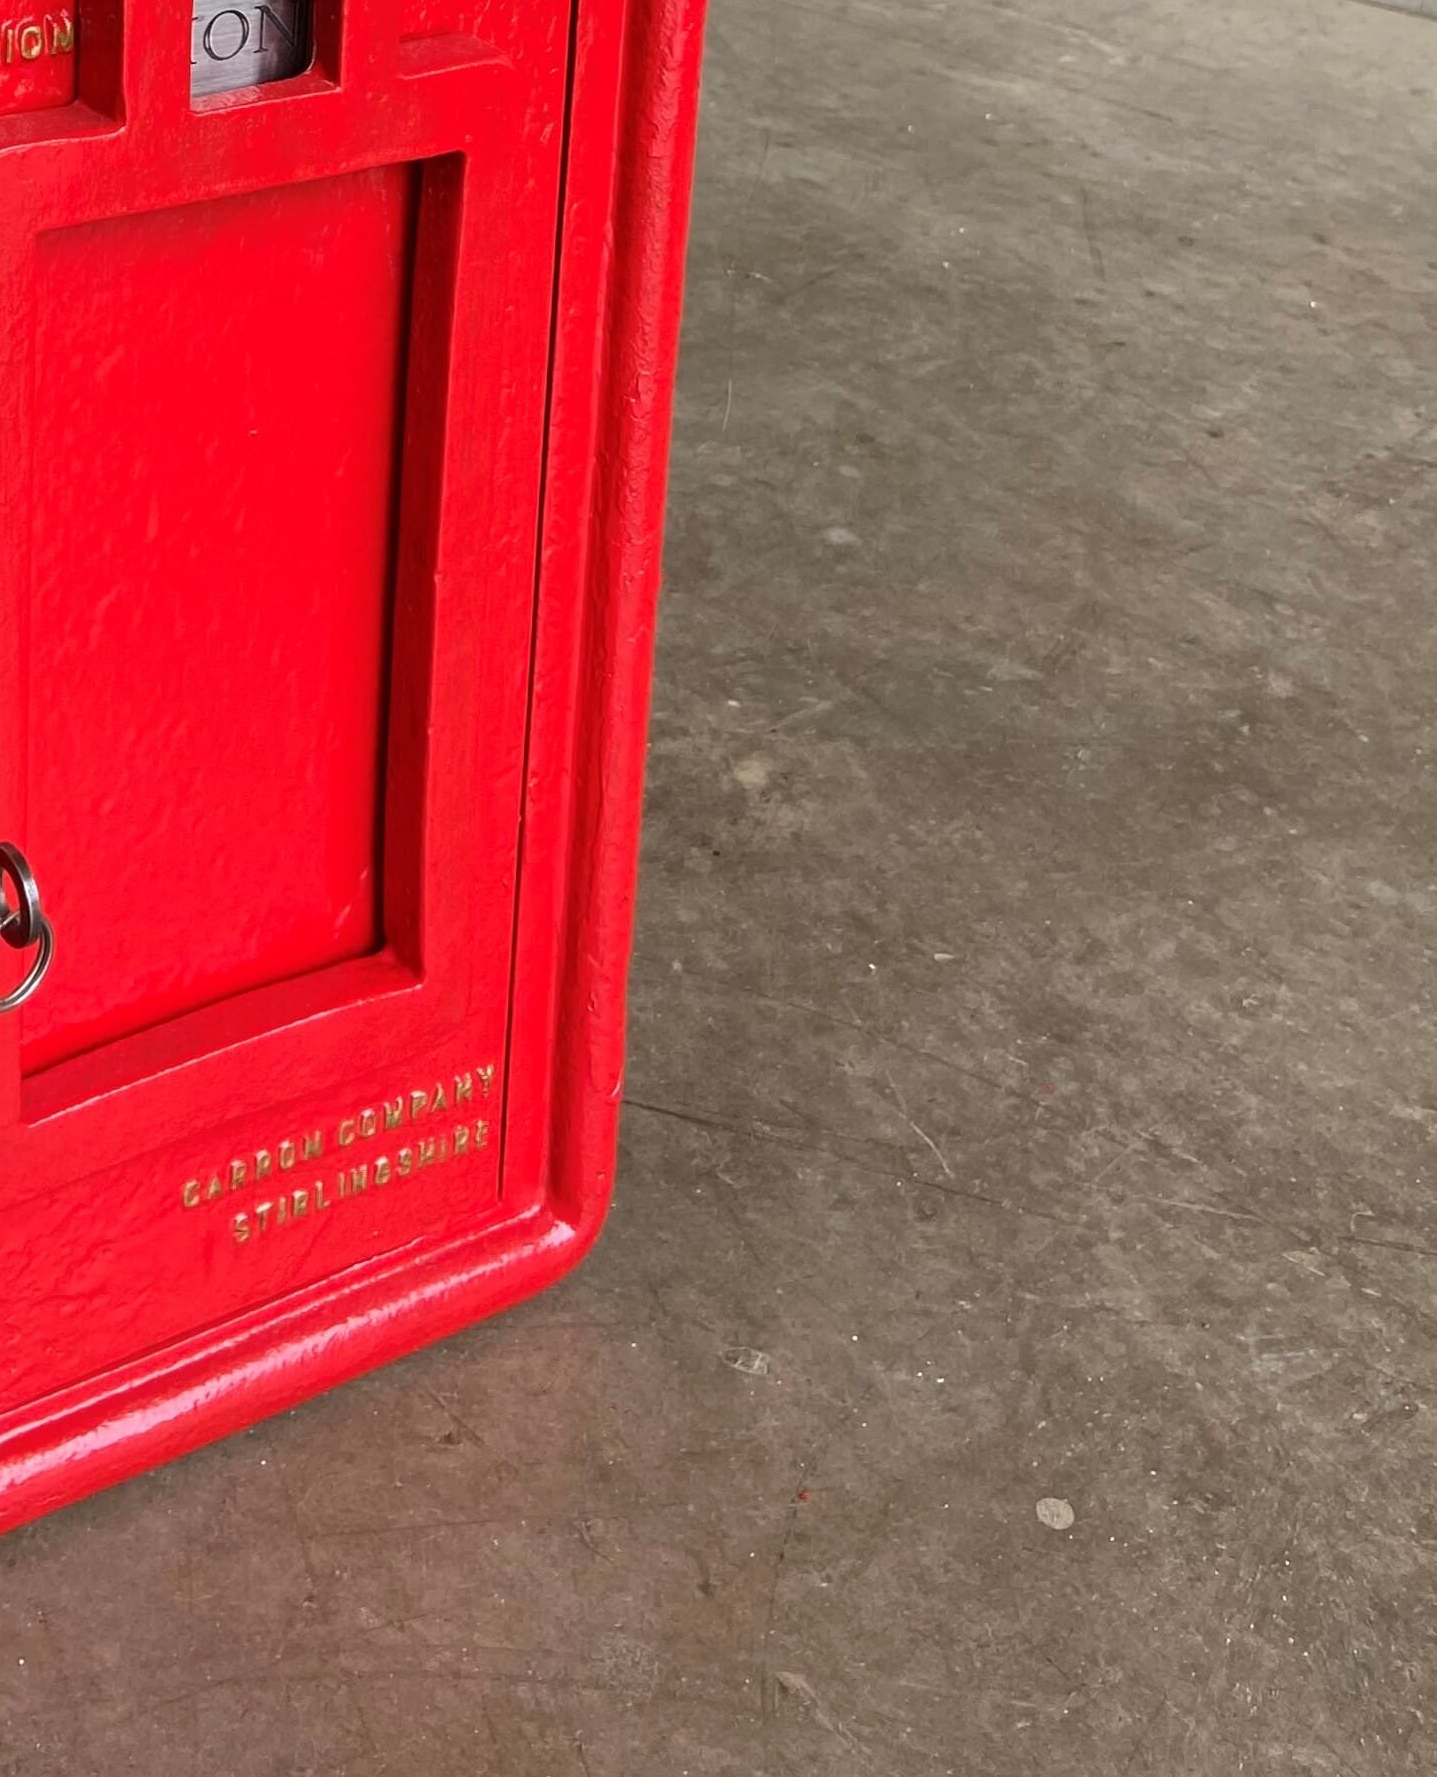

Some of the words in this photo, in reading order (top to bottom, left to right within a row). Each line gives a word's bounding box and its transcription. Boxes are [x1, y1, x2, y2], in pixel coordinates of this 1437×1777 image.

[190, 0, 300, 65] ON
[182, 1129, 323, 1209] CARRON
[337, 1063, 495, 1148] COMPANY
[232, 1119, 489, 1244] STIRLINGSHIRE
